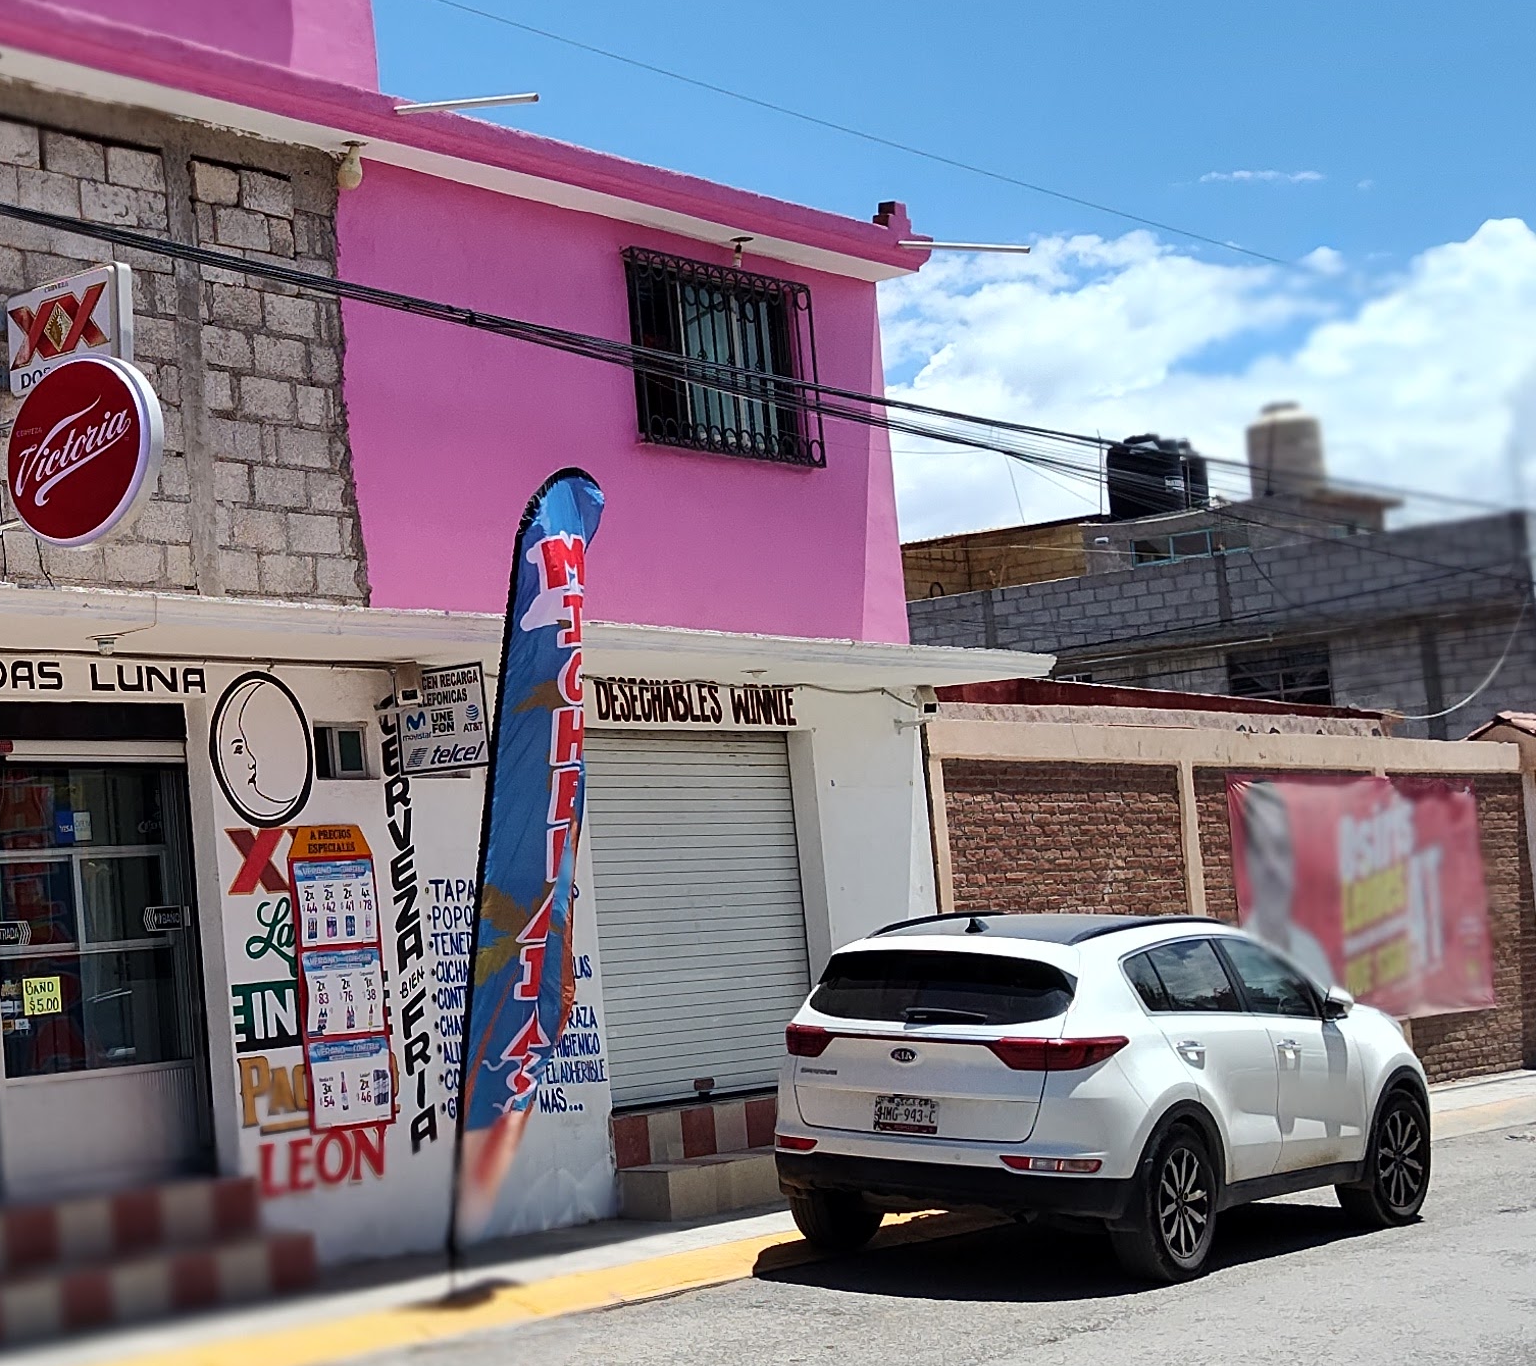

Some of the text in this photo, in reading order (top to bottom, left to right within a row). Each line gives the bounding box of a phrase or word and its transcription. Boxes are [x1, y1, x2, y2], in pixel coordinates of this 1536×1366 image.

[15, 394, 132, 507] Victoria
[89, 663, 207, 694] LUNA
[441, 670, 479, 688] RECARGA
[593, 676, 798, 727] DESECHABLES WINNIE
[431, 711, 454, 723] UNE
[463, 721, 483, 733] AT&T
[432, 722, 455, 734] FON
[430, 740, 485, 765] telcel
[318, 829, 351, 839] PRECIOS
[308, 843, 355, 854] ESPECIALES
[224, 826, 302, 896] X
[400, 966, 425, 1000] BIEN
[29, 997, 59, 1015] $5.00
[894, 1051, 913, 1060] KIA
[401, 987, 439, 1155] FRIA
[259, 1126, 387, 1199] LEON
